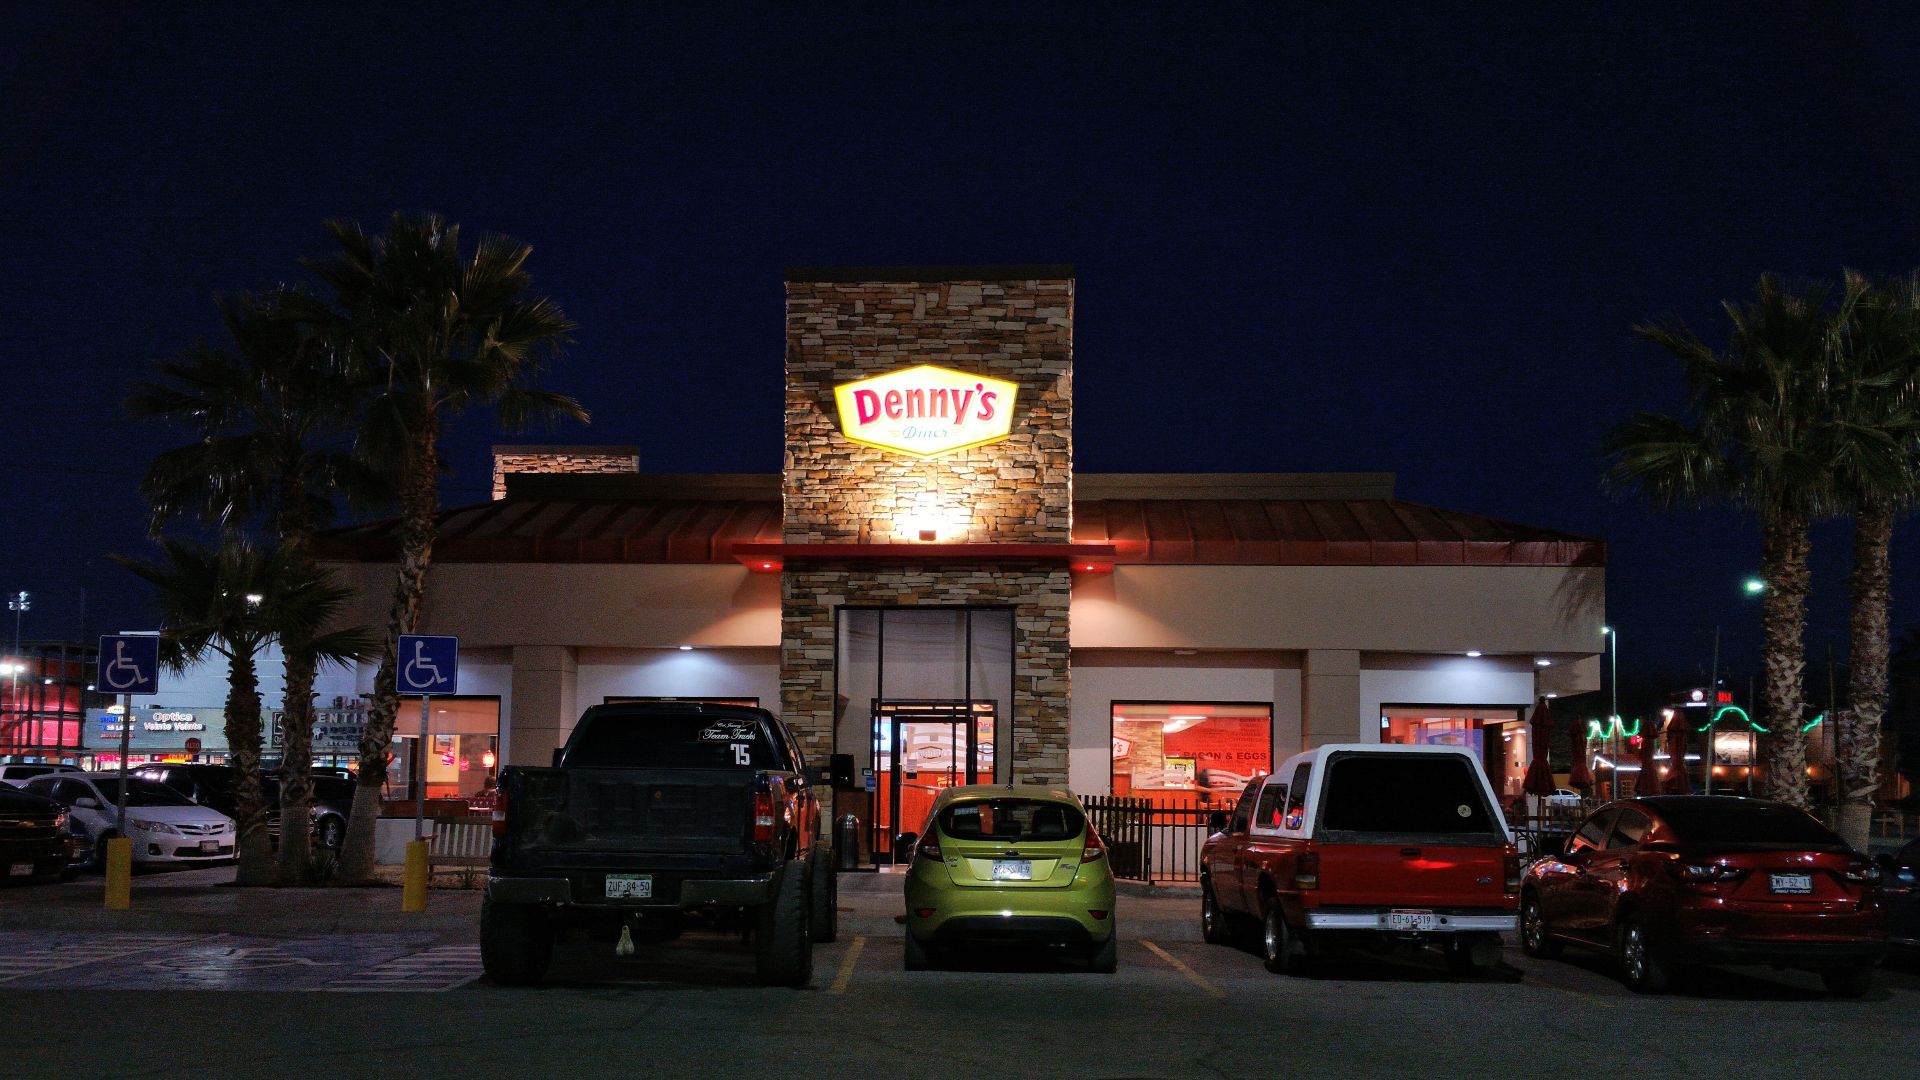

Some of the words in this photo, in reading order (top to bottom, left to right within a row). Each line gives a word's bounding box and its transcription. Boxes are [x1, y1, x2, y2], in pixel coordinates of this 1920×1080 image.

[853, 383, 998, 426] Denny's
[902, 425, 948, 439] Diner
[152, 711, 193, 723] Optica
[703, 729, 730, 740] Team
[731, 729, 756, 740] Trucks
[1225, 751, 1233, 760] &
[1236, 751, 1267, 760] EGGS
